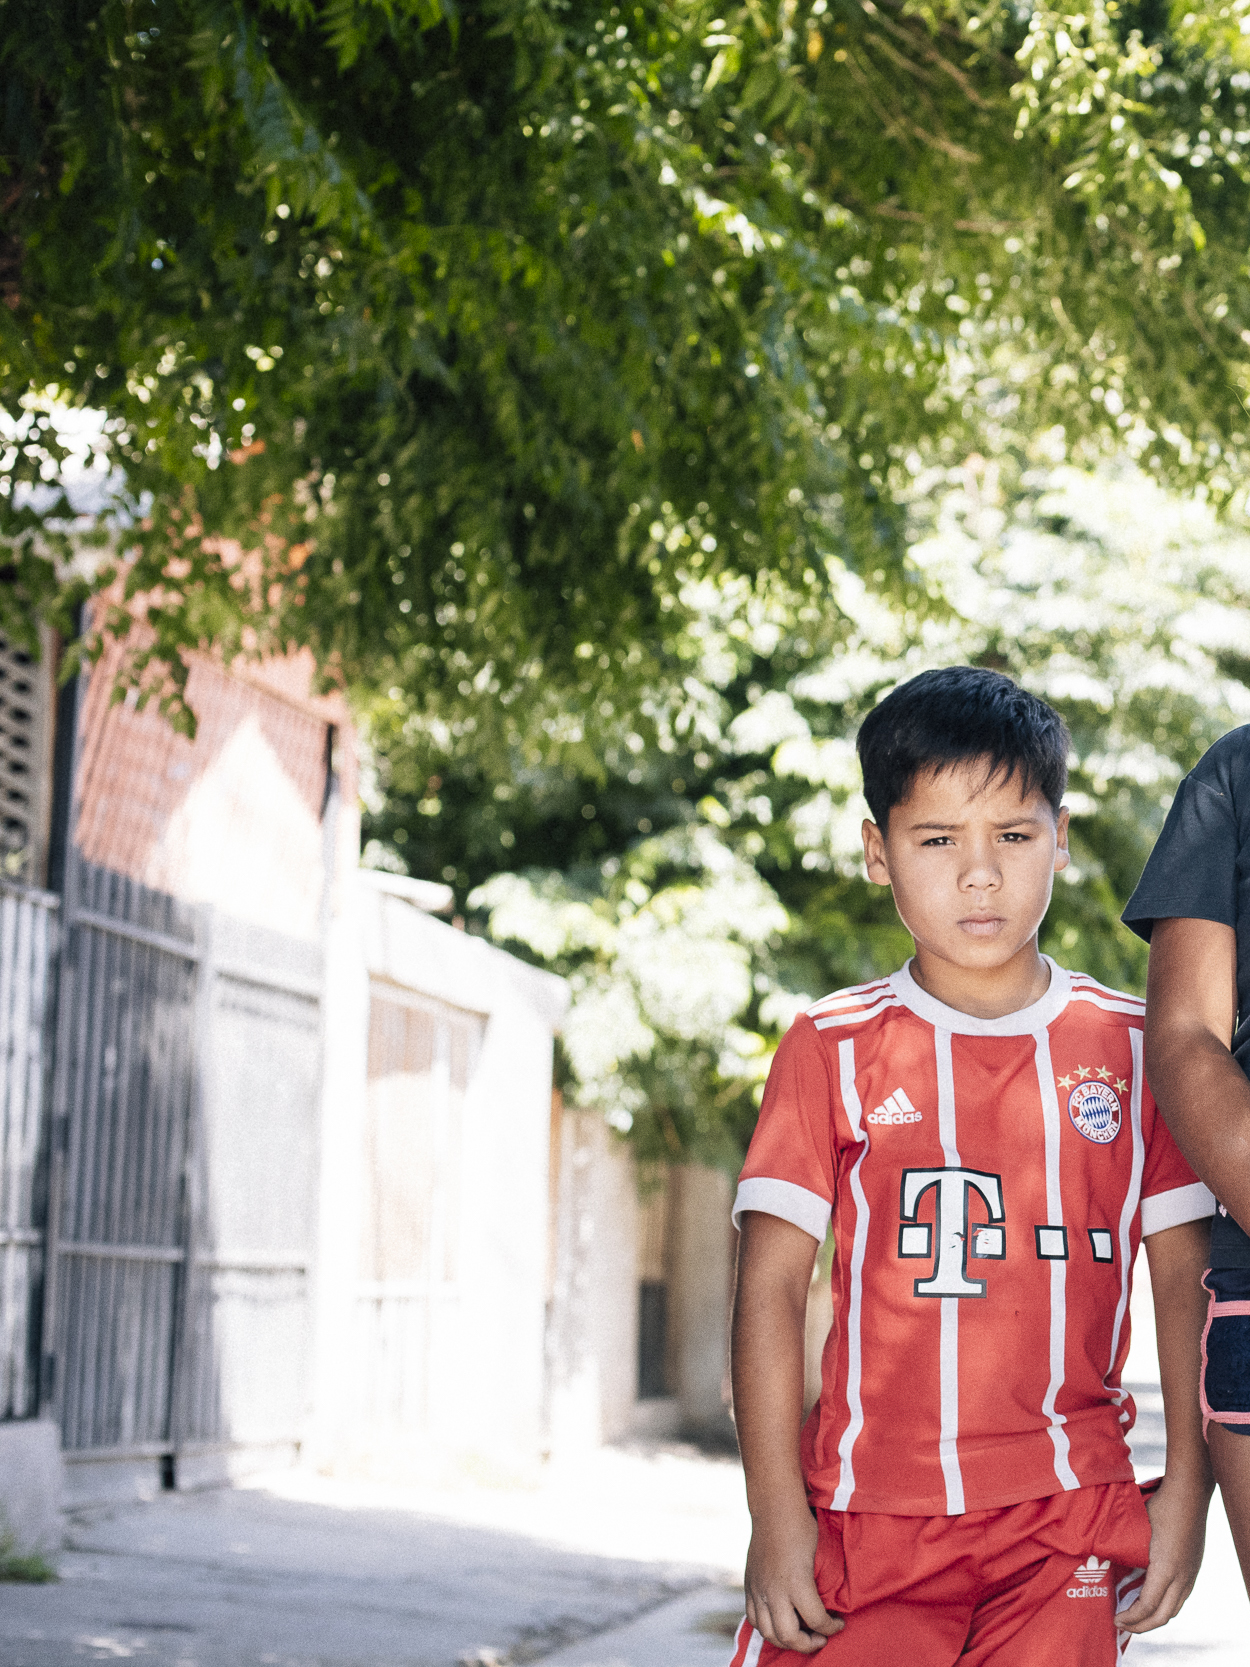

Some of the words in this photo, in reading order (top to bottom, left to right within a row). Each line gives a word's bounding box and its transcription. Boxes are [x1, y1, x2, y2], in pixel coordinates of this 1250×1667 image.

[1071, 1092, 1083, 1108] FC
[1080, 1084, 1119, 1112] BAYERN
[867, 1110, 923, 1125] adidas
[1066, 1585, 1108, 1598] adidas
